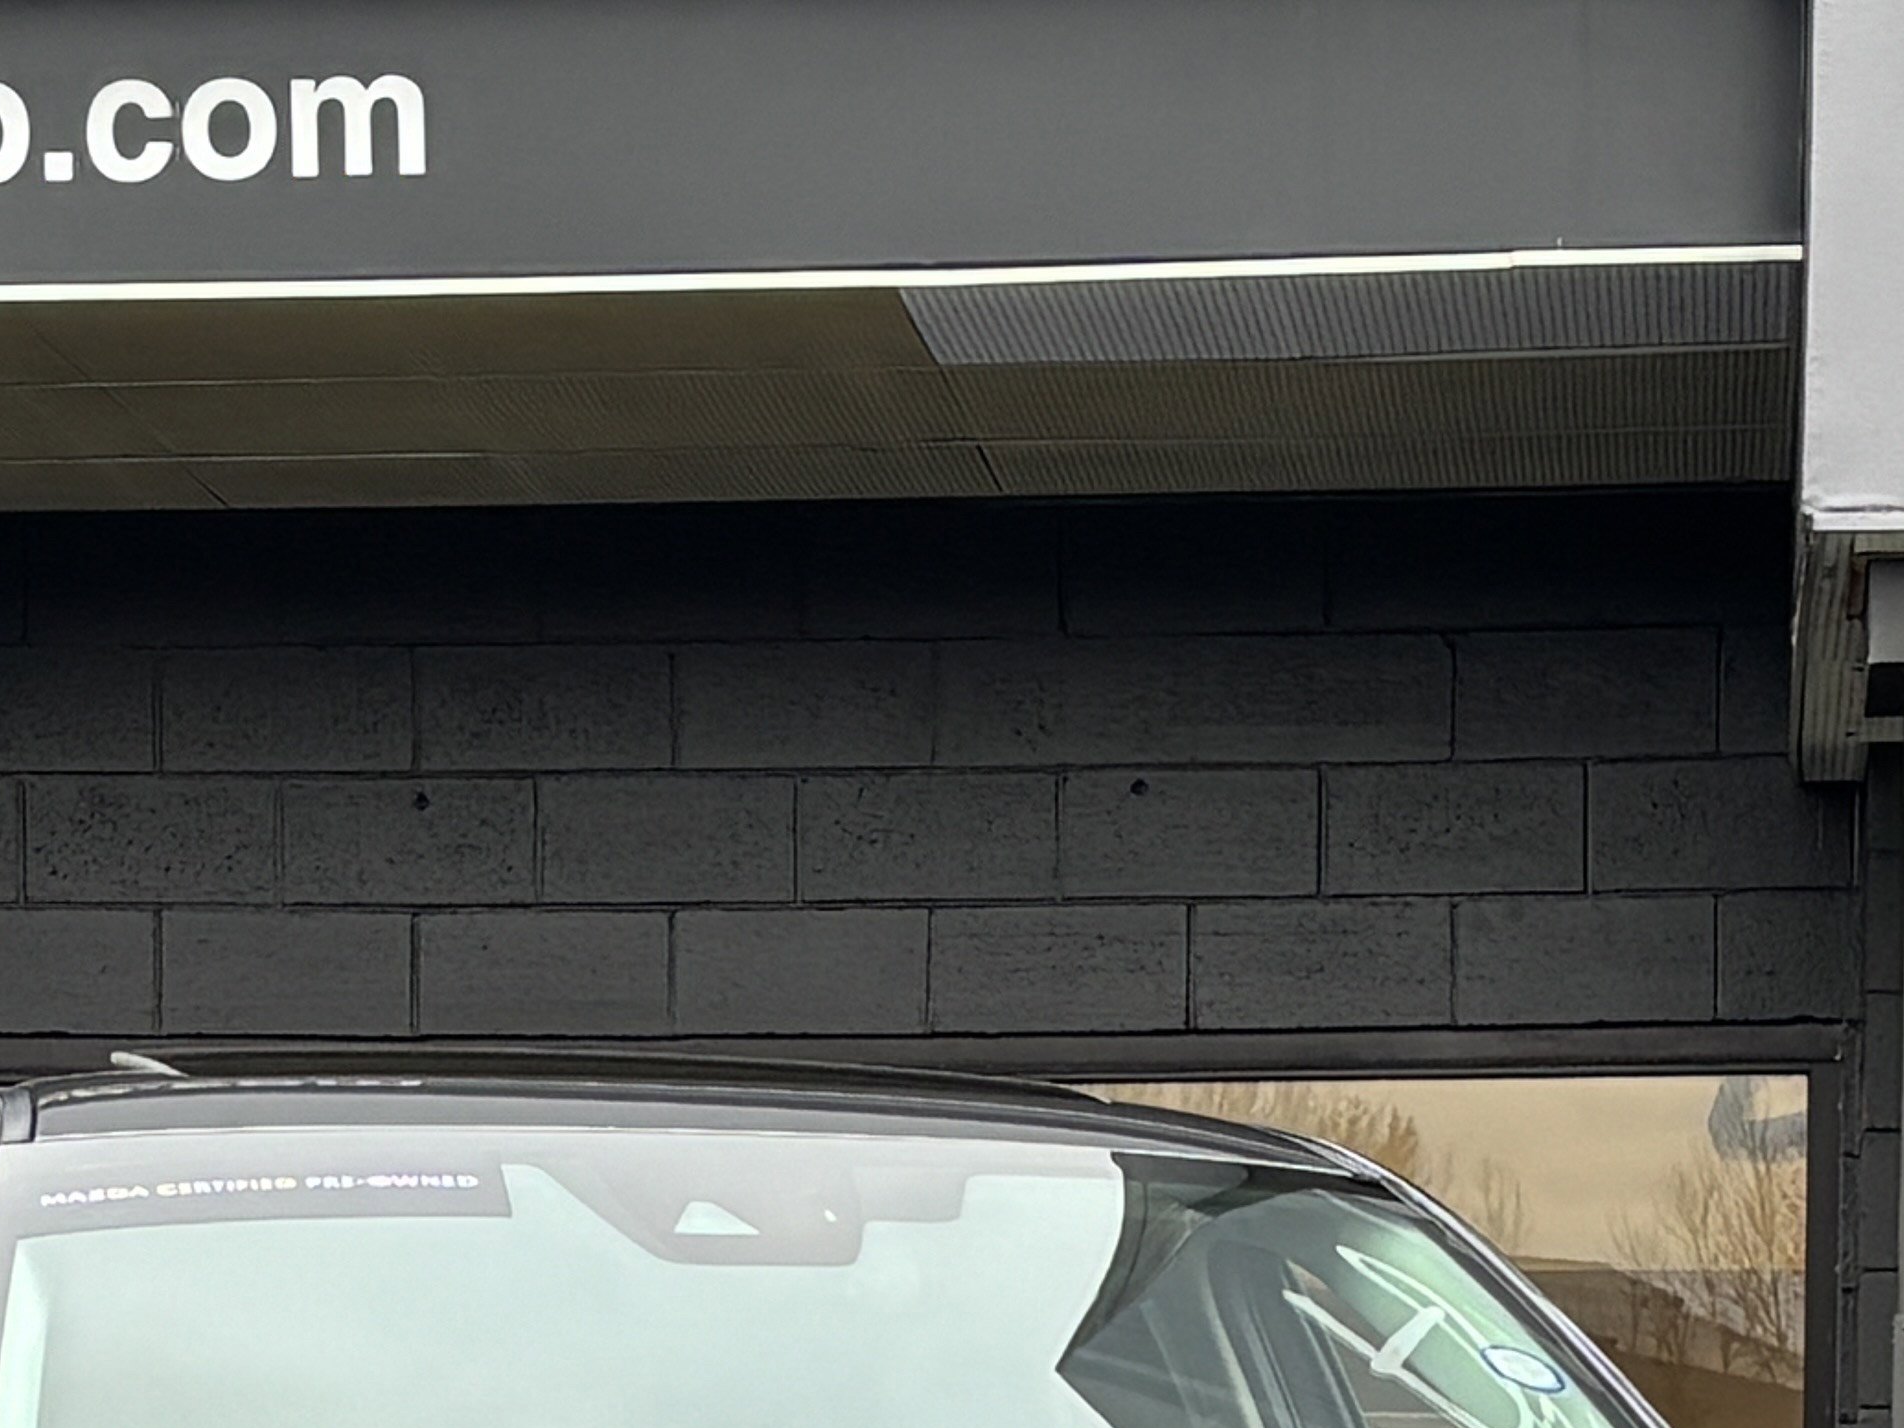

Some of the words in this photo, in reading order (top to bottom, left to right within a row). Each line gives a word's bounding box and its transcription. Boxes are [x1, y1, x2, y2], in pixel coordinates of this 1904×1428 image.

[41, 1184, 150, 1207] MAZDA
[156, 1177, 297, 1198] CERTIFIED
[305, 1173, 480, 1191] PRE-OWNED
